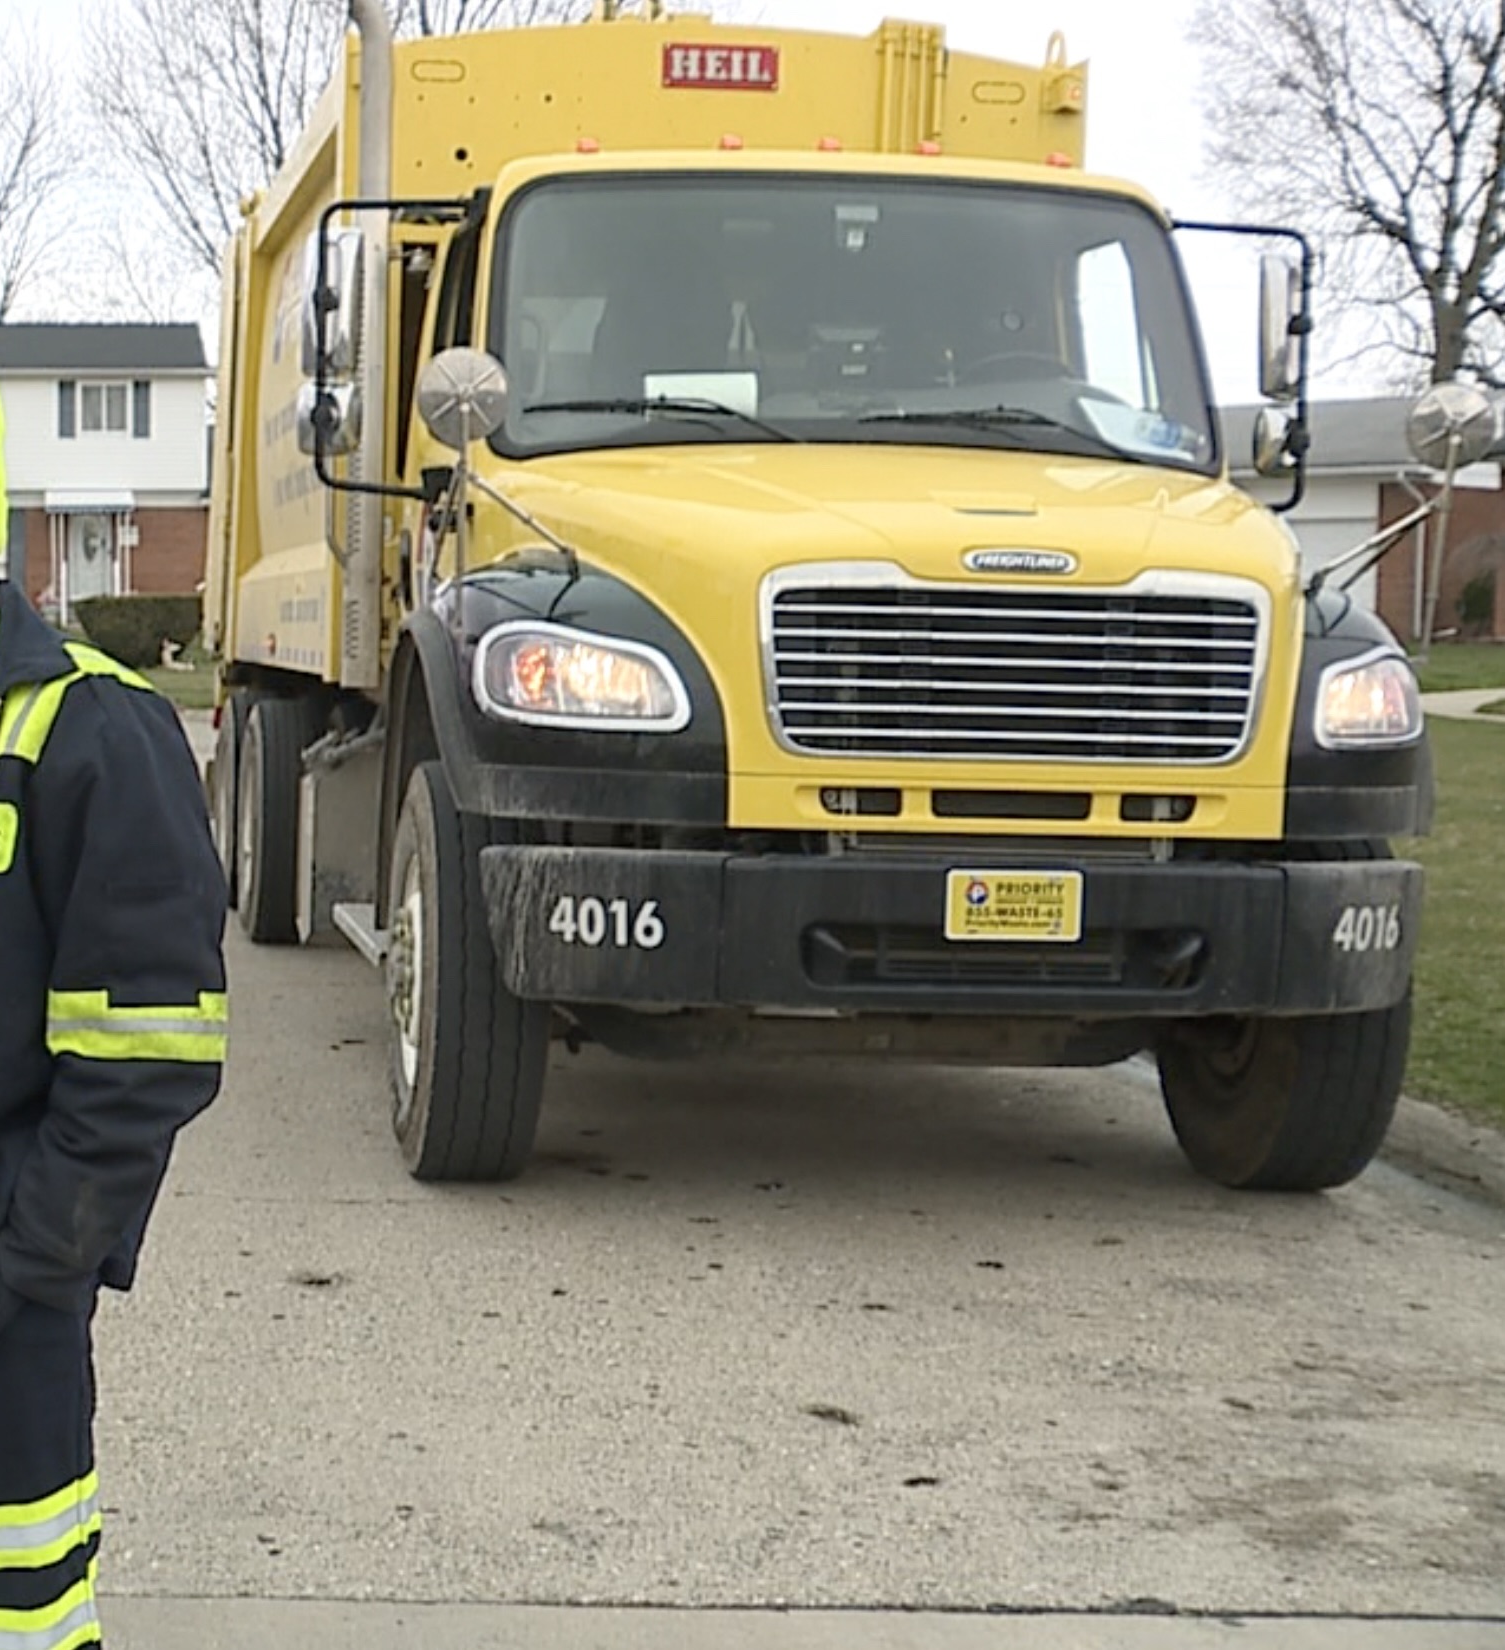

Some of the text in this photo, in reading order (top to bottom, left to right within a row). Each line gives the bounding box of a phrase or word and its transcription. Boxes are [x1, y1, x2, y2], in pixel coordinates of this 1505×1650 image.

[671, 49, 771, 82] HEIL
[995, 882, 1065, 895] PRIORITY
[549, 895, 664, 948] 4016
[1333, 904, 1399, 952] 4016
